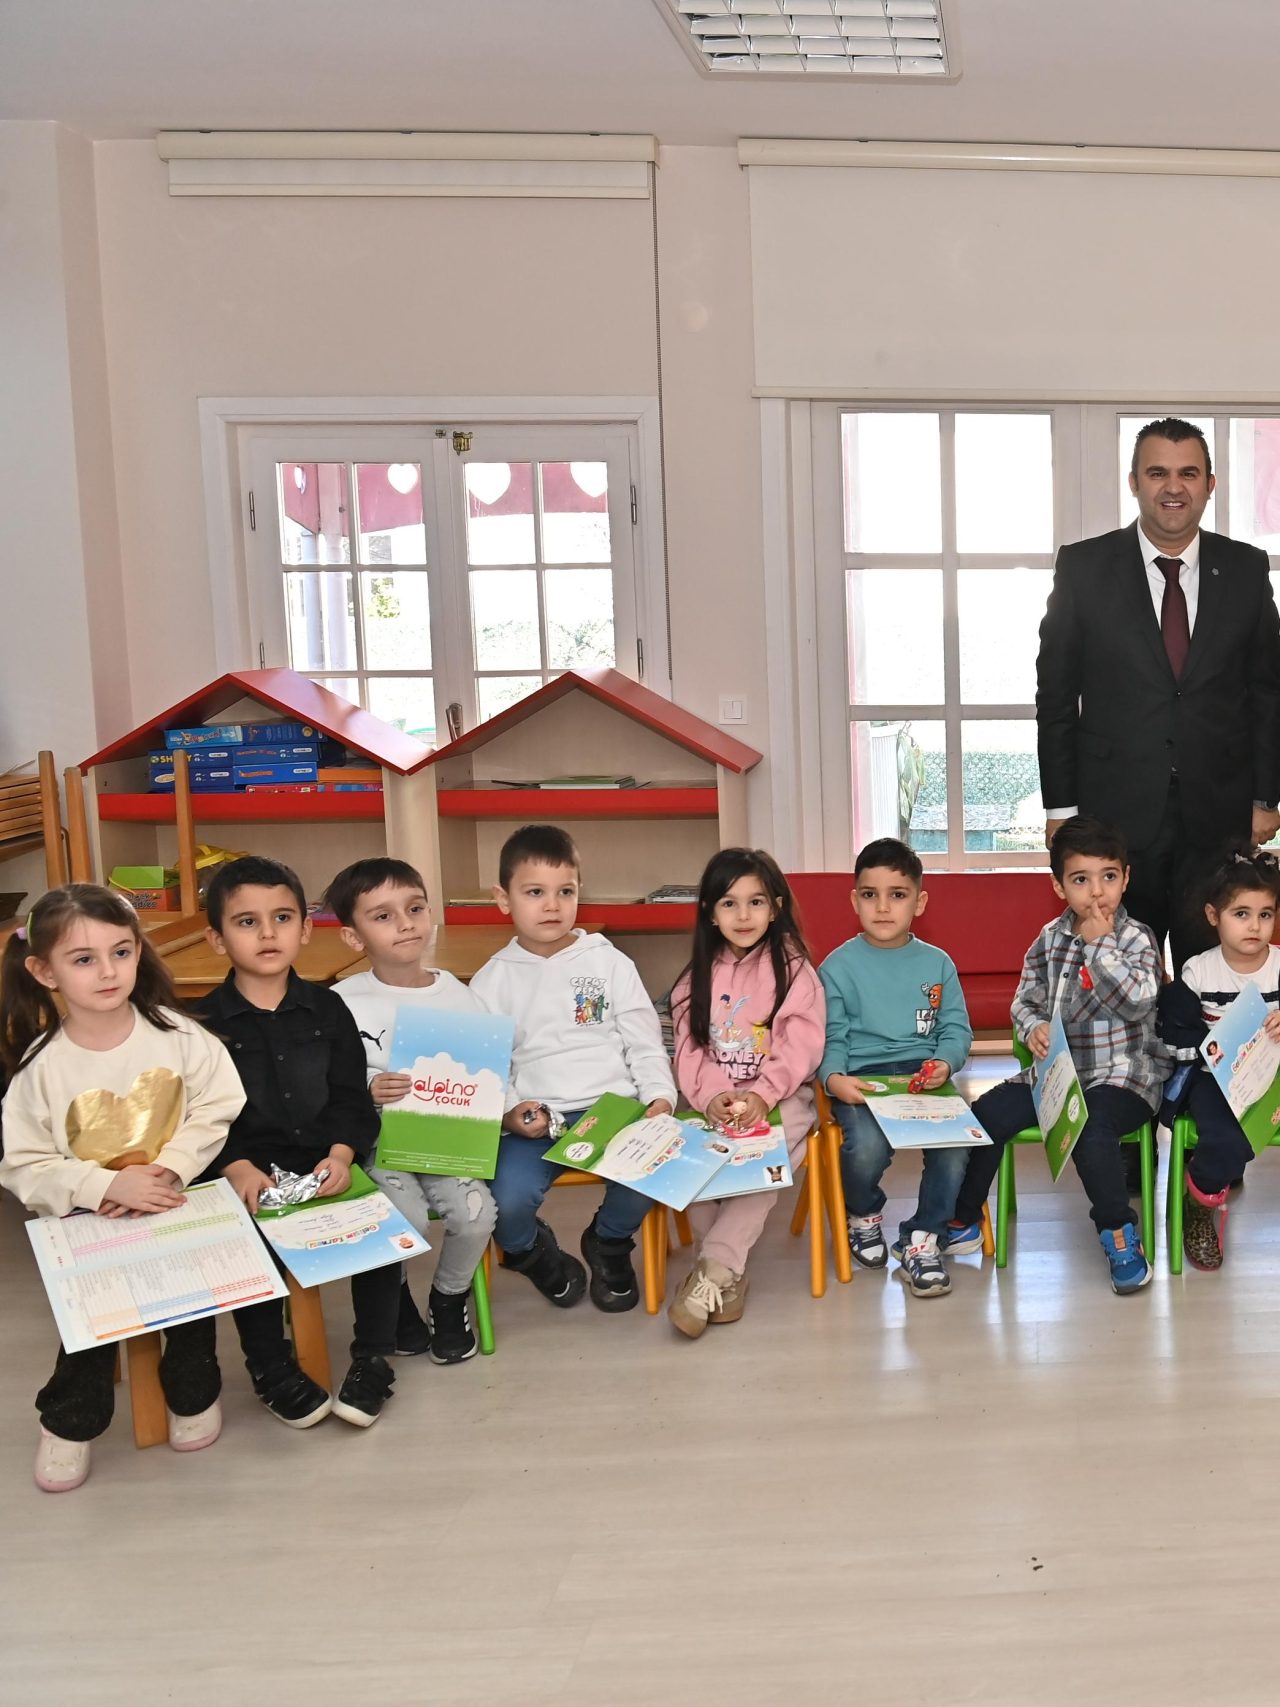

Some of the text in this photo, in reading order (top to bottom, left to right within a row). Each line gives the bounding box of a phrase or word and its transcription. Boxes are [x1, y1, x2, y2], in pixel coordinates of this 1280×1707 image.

[160, 755, 192, 763] SHY
[711, 1049, 766, 1066] ONEY
[413, 1075, 476, 1102] alpino
